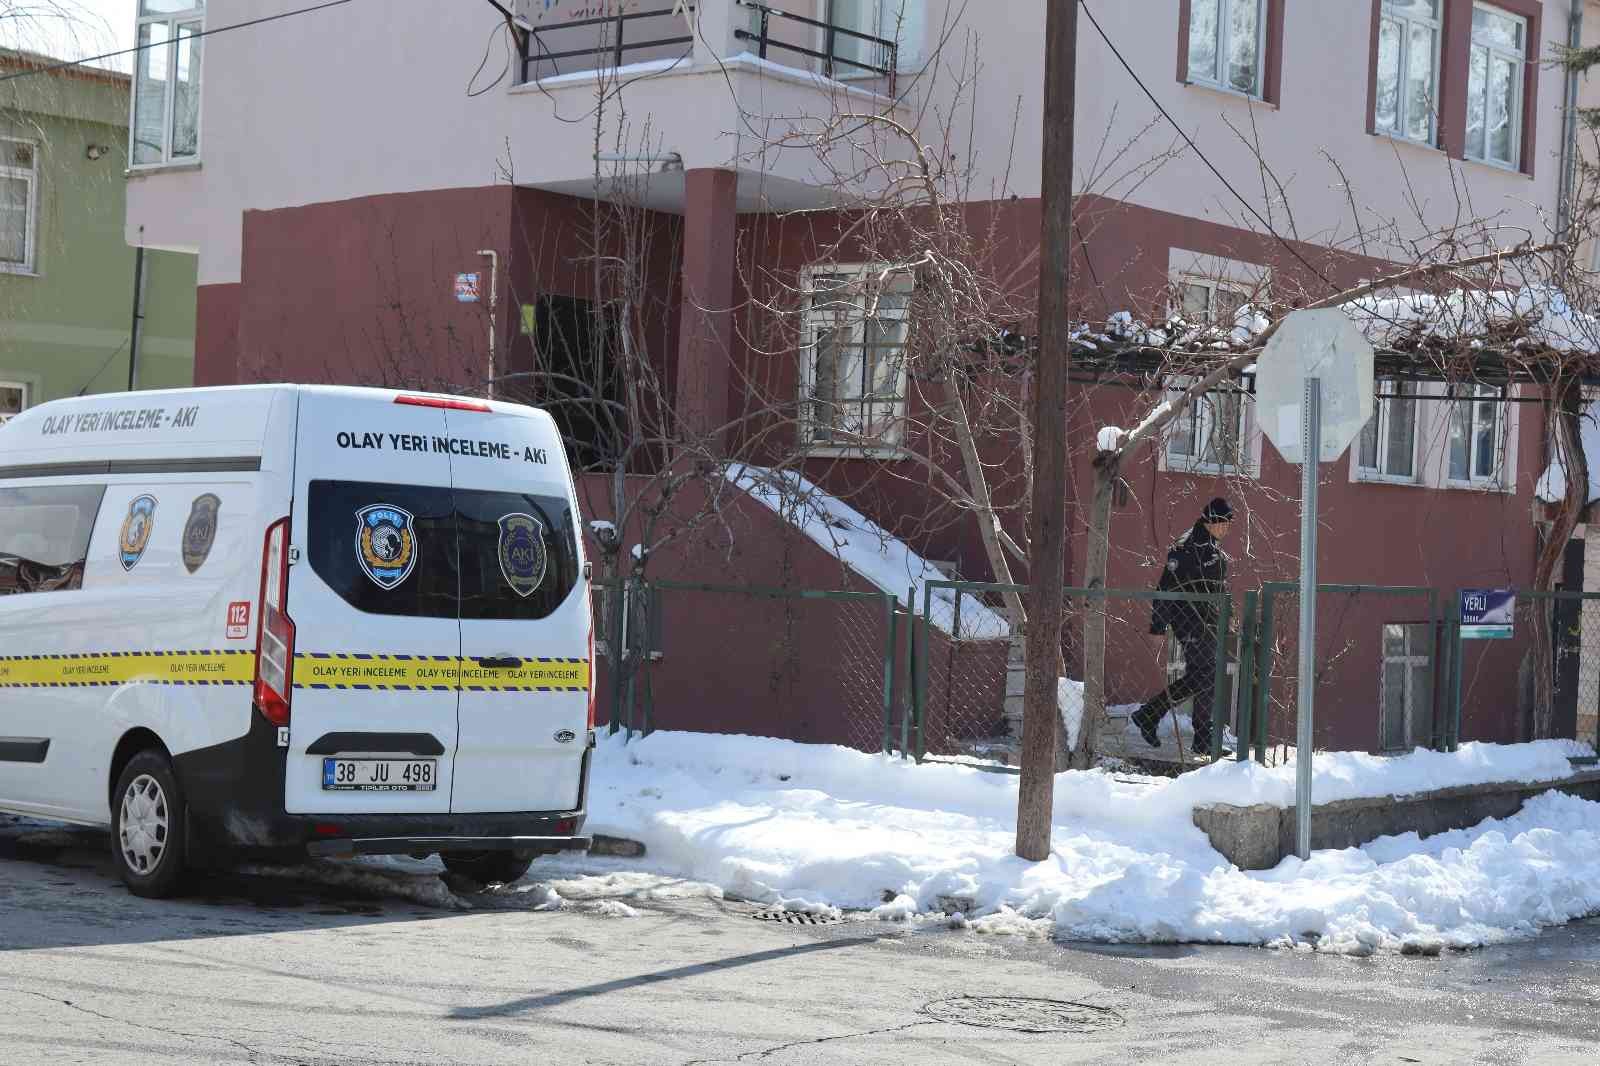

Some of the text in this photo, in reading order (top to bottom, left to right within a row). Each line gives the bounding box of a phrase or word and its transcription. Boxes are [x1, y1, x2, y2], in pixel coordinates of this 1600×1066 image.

[42, 416, 72, 434] OLAY
[336, 431, 384, 449] OLAY
[231, 606, 247, 623] 112
[312, 666, 338, 676] OLAY
[416, 668, 440, 678] OLAY
[507, 670, 527, 679] OLAY
[336, 763, 431, 783] 38 JU 498
